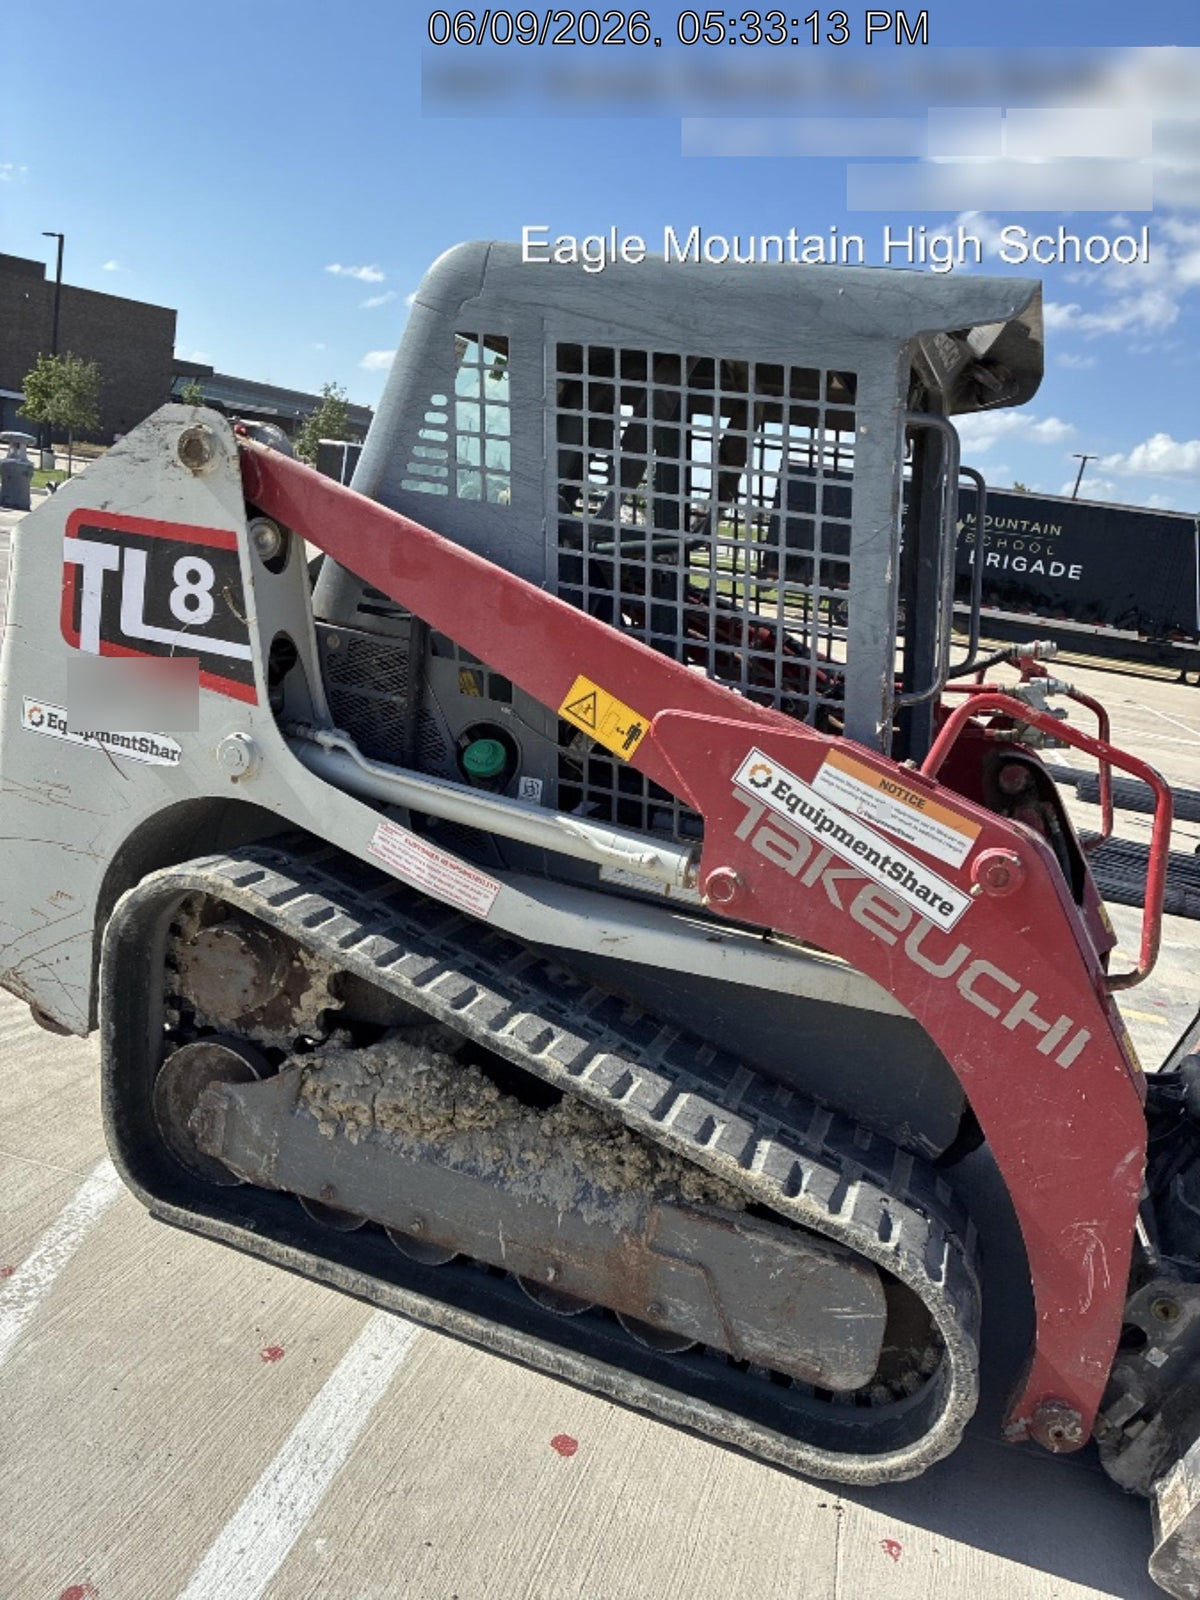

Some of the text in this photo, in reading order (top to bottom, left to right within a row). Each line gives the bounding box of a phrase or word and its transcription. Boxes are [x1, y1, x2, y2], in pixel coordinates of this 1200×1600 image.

[63, 536, 252, 655] TL8
[771, 779, 954, 917] EquipmentShare
[879, 778, 926, 810] NOTICE
